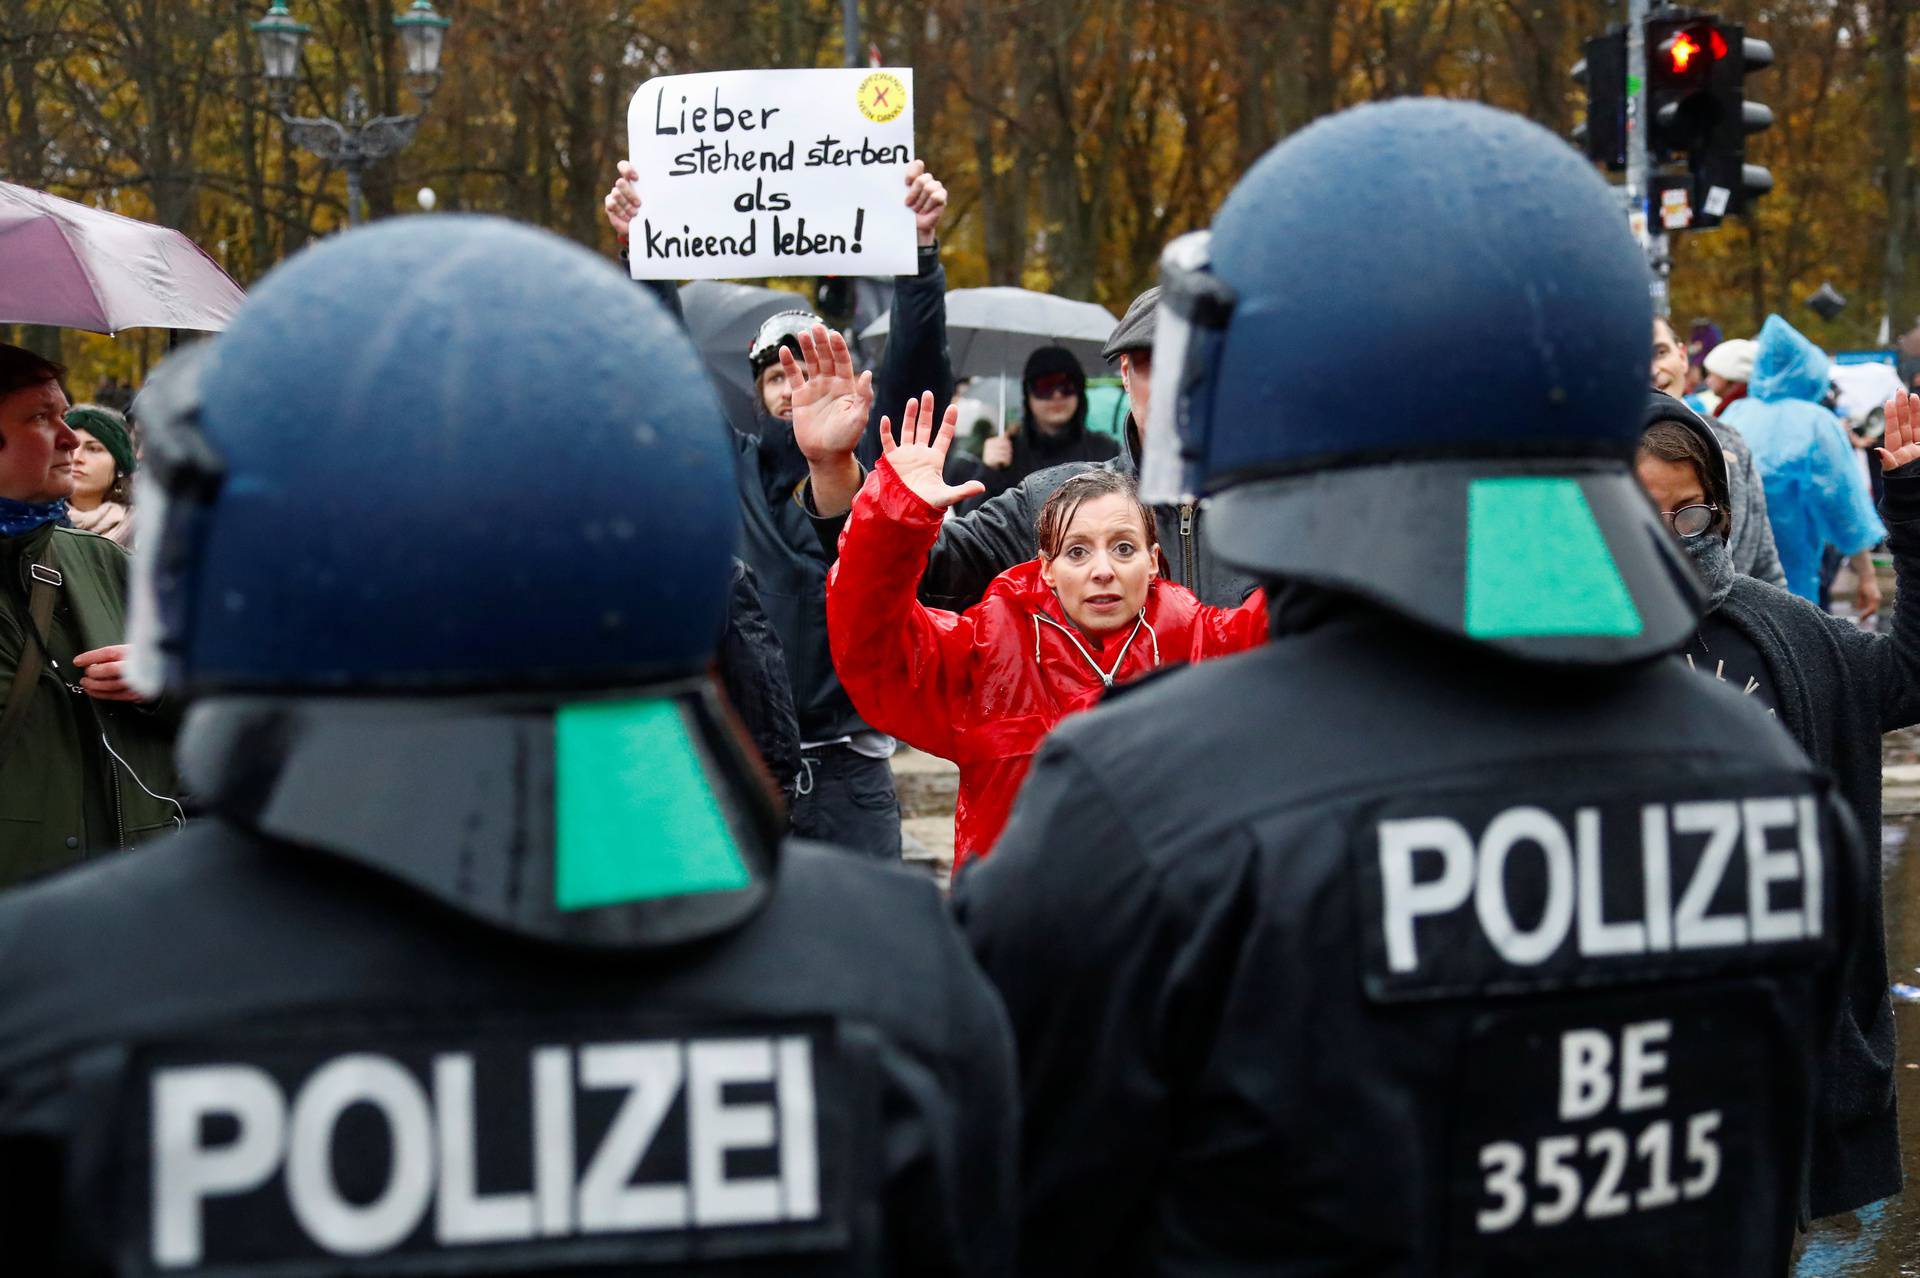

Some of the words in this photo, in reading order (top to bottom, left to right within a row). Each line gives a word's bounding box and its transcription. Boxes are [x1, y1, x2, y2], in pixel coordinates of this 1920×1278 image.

[655, 86, 780, 135] Lieber
[857, 100, 875, 120] NEIN
[876, 103, 905, 122] DANKE
[669, 138, 795, 176] stehend
[804, 134, 911, 167] sterben
[733, 177, 792, 213] als
[645, 217, 756, 259] knieend
[773, 207, 865, 256] leben!
[1378, 795, 1823, 974] POLIZEI
[1558, 1018, 1673, 1121] BE
[150, 1034, 821, 1269] POLIZEI
[1476, 1109, 1723, 1233] 35215
